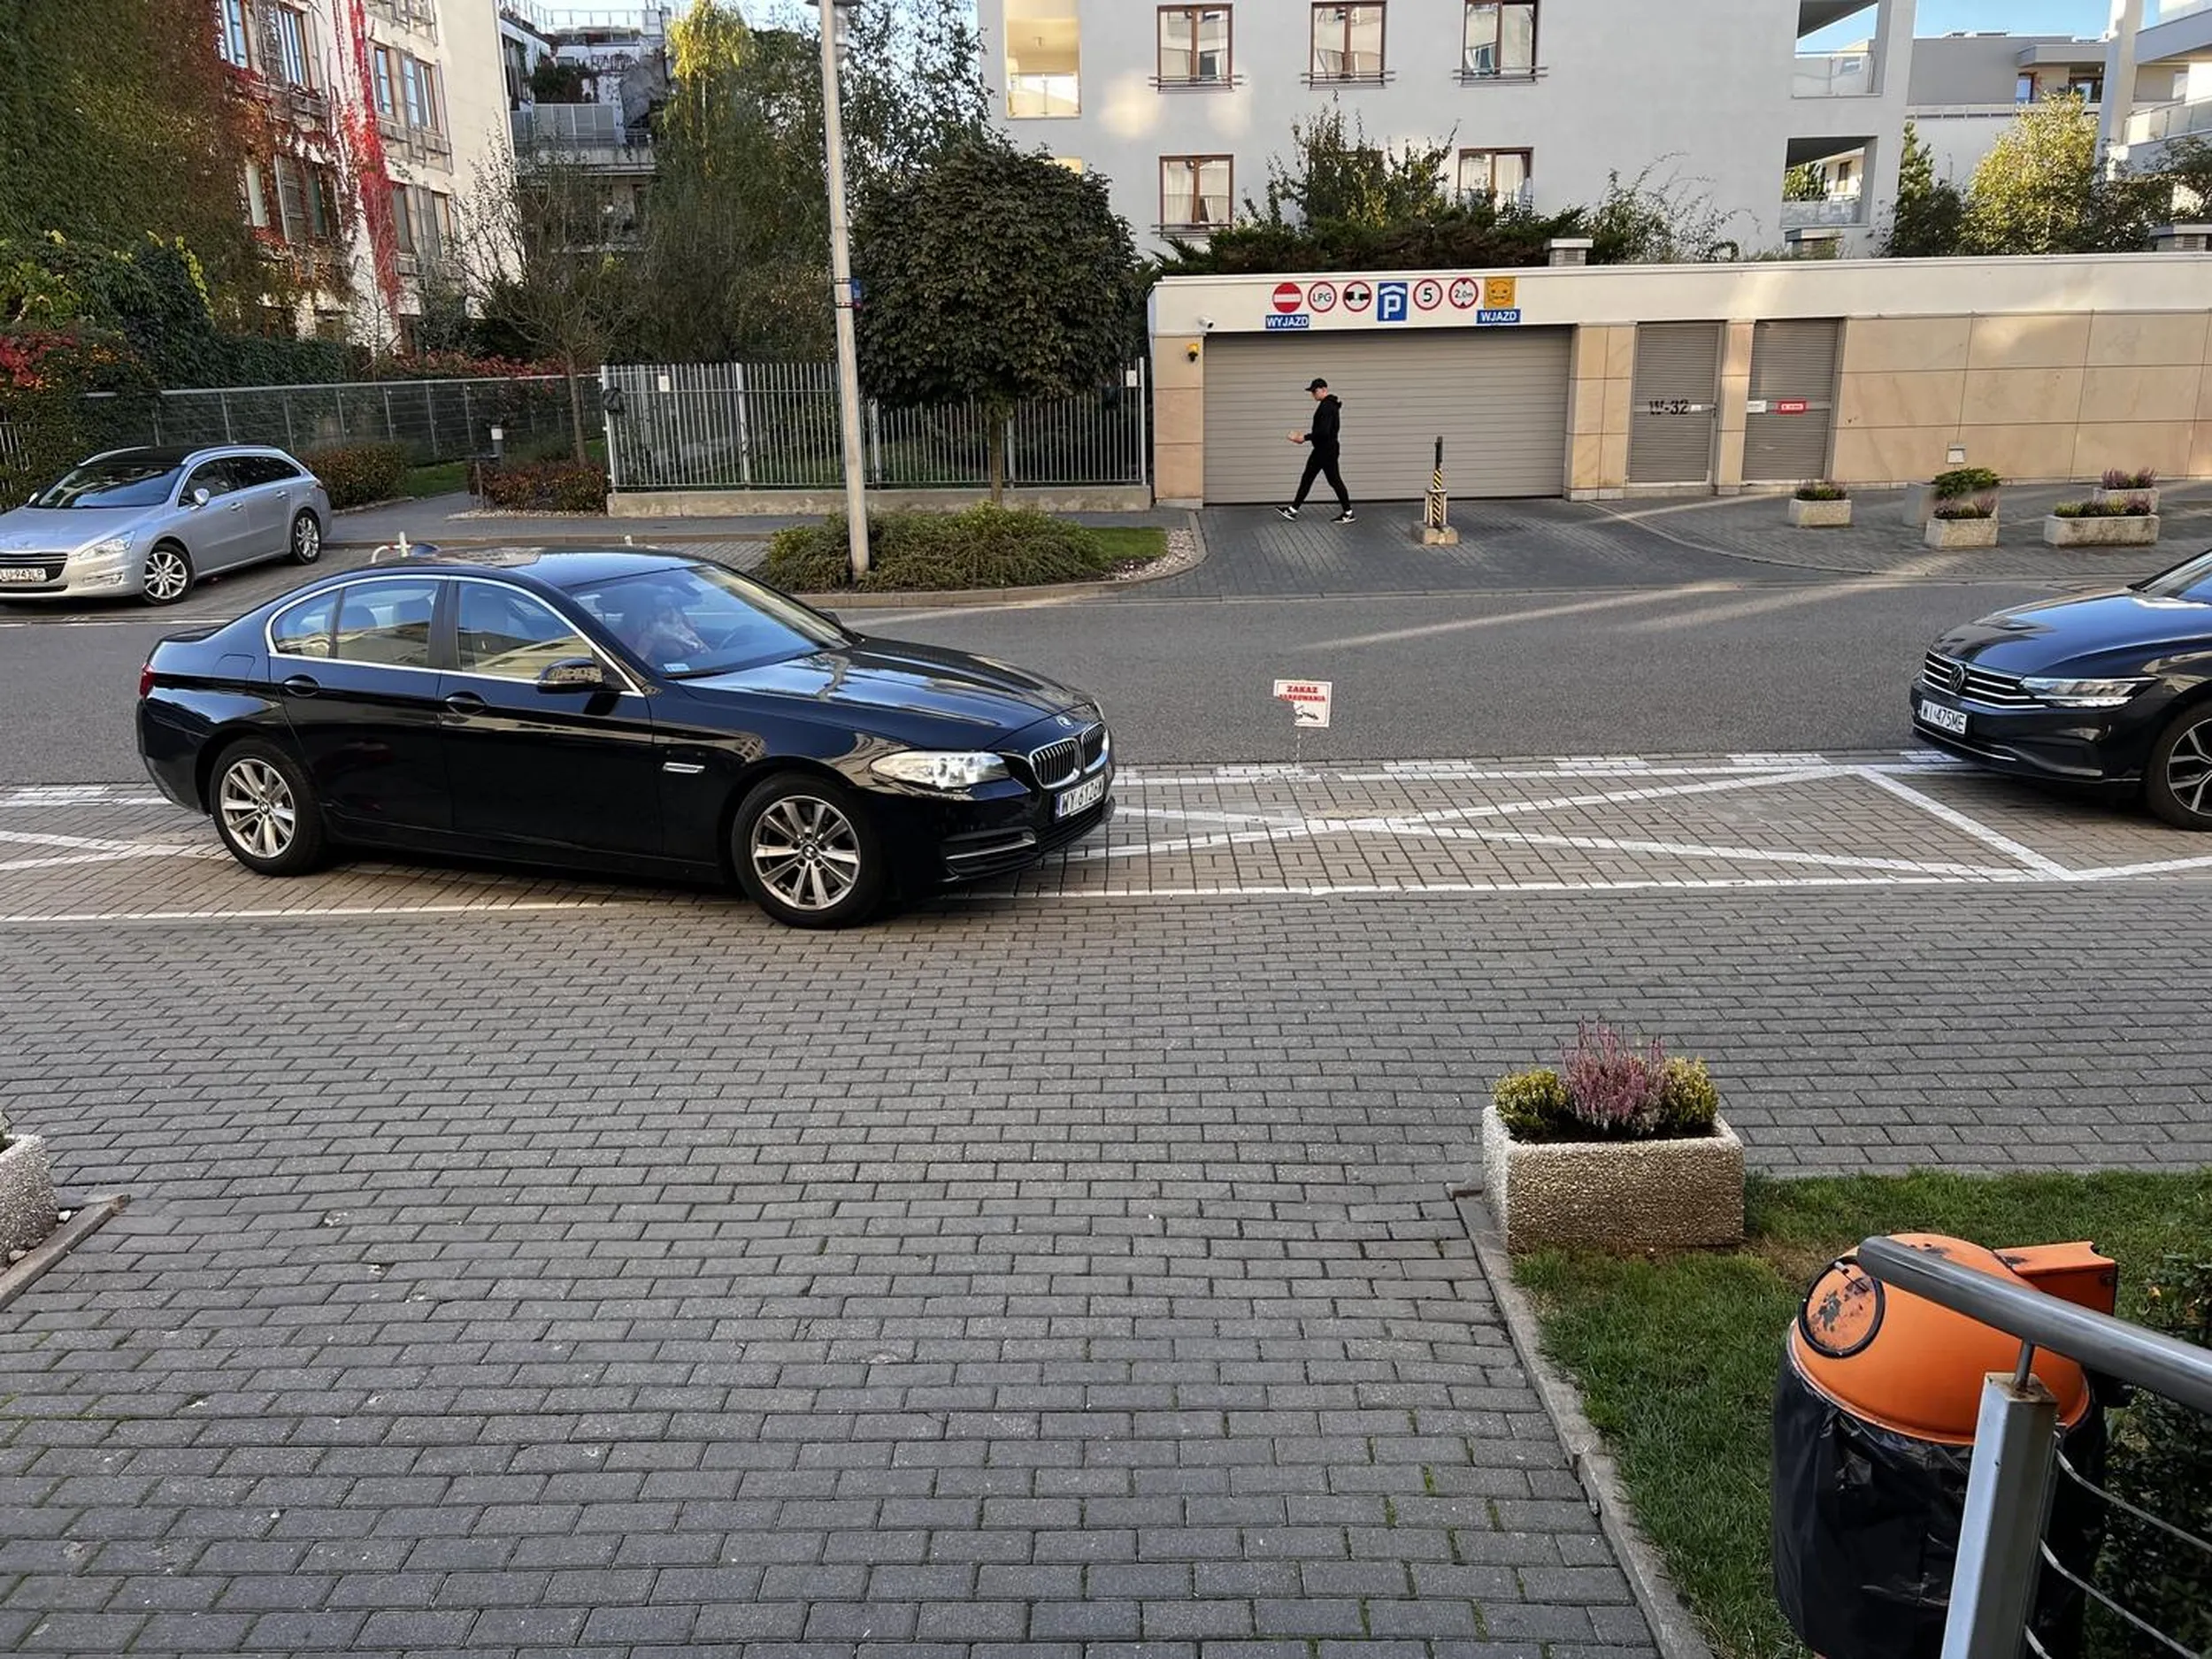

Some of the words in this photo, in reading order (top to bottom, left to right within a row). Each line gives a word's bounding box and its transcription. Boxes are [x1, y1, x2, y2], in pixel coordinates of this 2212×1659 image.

[1312, 292, 1332, 302] LPG
[1422, 287, 1432, 303] 5
[1383, 294, 1402, 319] P
[1480, 311, 1517, 322] WJAZD
[1266, 317, 1309, 327] WYJAZD
[1286, 685, 1318, 694] ZAKAZ
